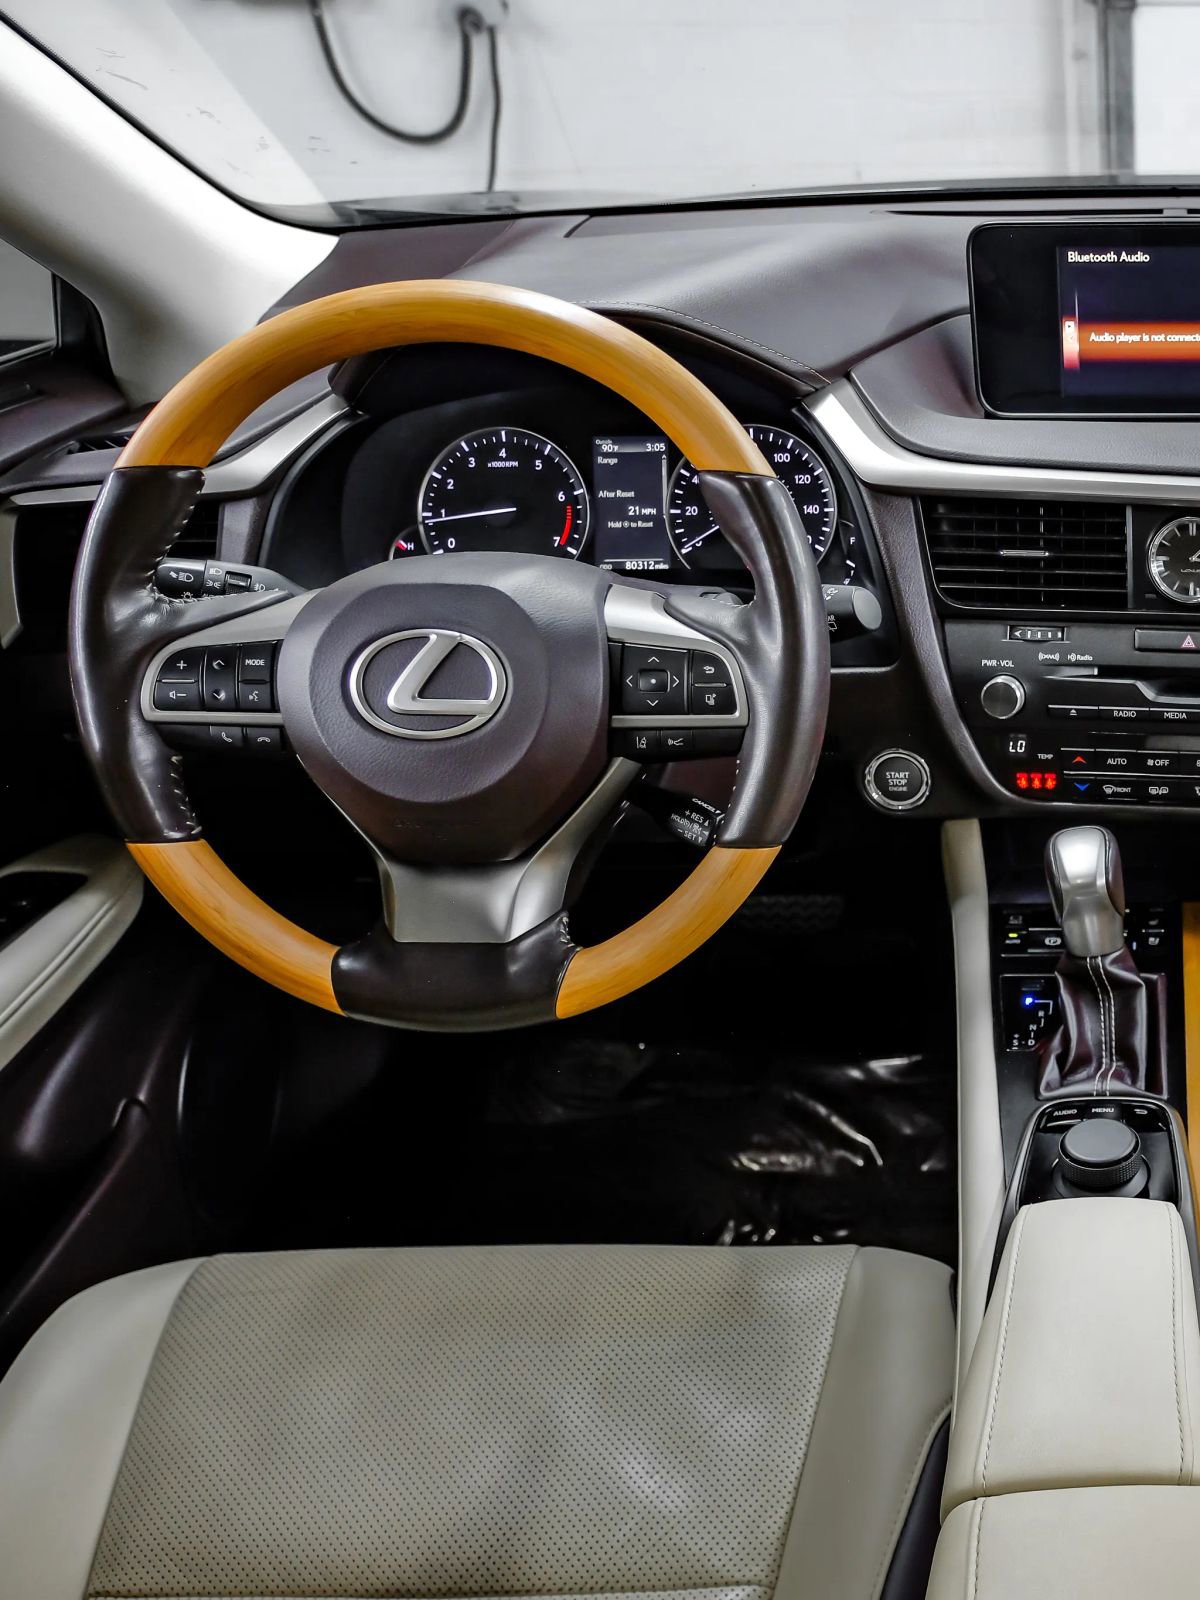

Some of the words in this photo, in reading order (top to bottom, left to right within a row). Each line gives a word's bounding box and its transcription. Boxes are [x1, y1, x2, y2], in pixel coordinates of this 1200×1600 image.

[1067, 251, 1118, 263] Bluetooth
[1119, 251, 1151, 263] Audio
[1089, 331, 1115, 342] Audio
[1116, 331, 1142, 344] player
[1142, 332, 1150, 342] is
[1151, 333, 1166, 342] not
[646, 443, 666, 452] 3:05
[499, 448, 507, 458] 4
[773, 453, 790, 463] 100
[468, 457, 476, 468] 3
[535, 460, 543, 471] 5
[597, 456, 618, 466] Range
[794, 474, 811, 484] 120
[447, 479, 455, 490] 2
[557, 491, 566, 502] 6
[598, 490, 616, 498] After
[616, 490, 635, 498] Reset
[628, 505, 640, 516] 21
[685, 506, 698, 516] 20
[803, 504, 820, 515] 140
[638, 520, 654, 528] Reset
[447, 537, 456, 549] 0
[553, 536, 560, 547] 7
[850, 536, 856, 545] F
[407, 542, 415, 551] H
[1113, 710, 1137, 719] RADIO
[1163, 711, 1187, 720] MEDIA
[1106, 758, 1128, 766] AUTO
[1154, 759, 1170, 767] OFF
[885, 771, 910, 779] START
[888, 778, 908, 786] STOP
[690, 812, 705, 824] RES
[683, 830, 697, 841] SET
[1029, 1024, 1038, 1032] N
[1027, 1039, 1036, 1047] D
[1053, 1108, 1078, 1117] AUDIO
